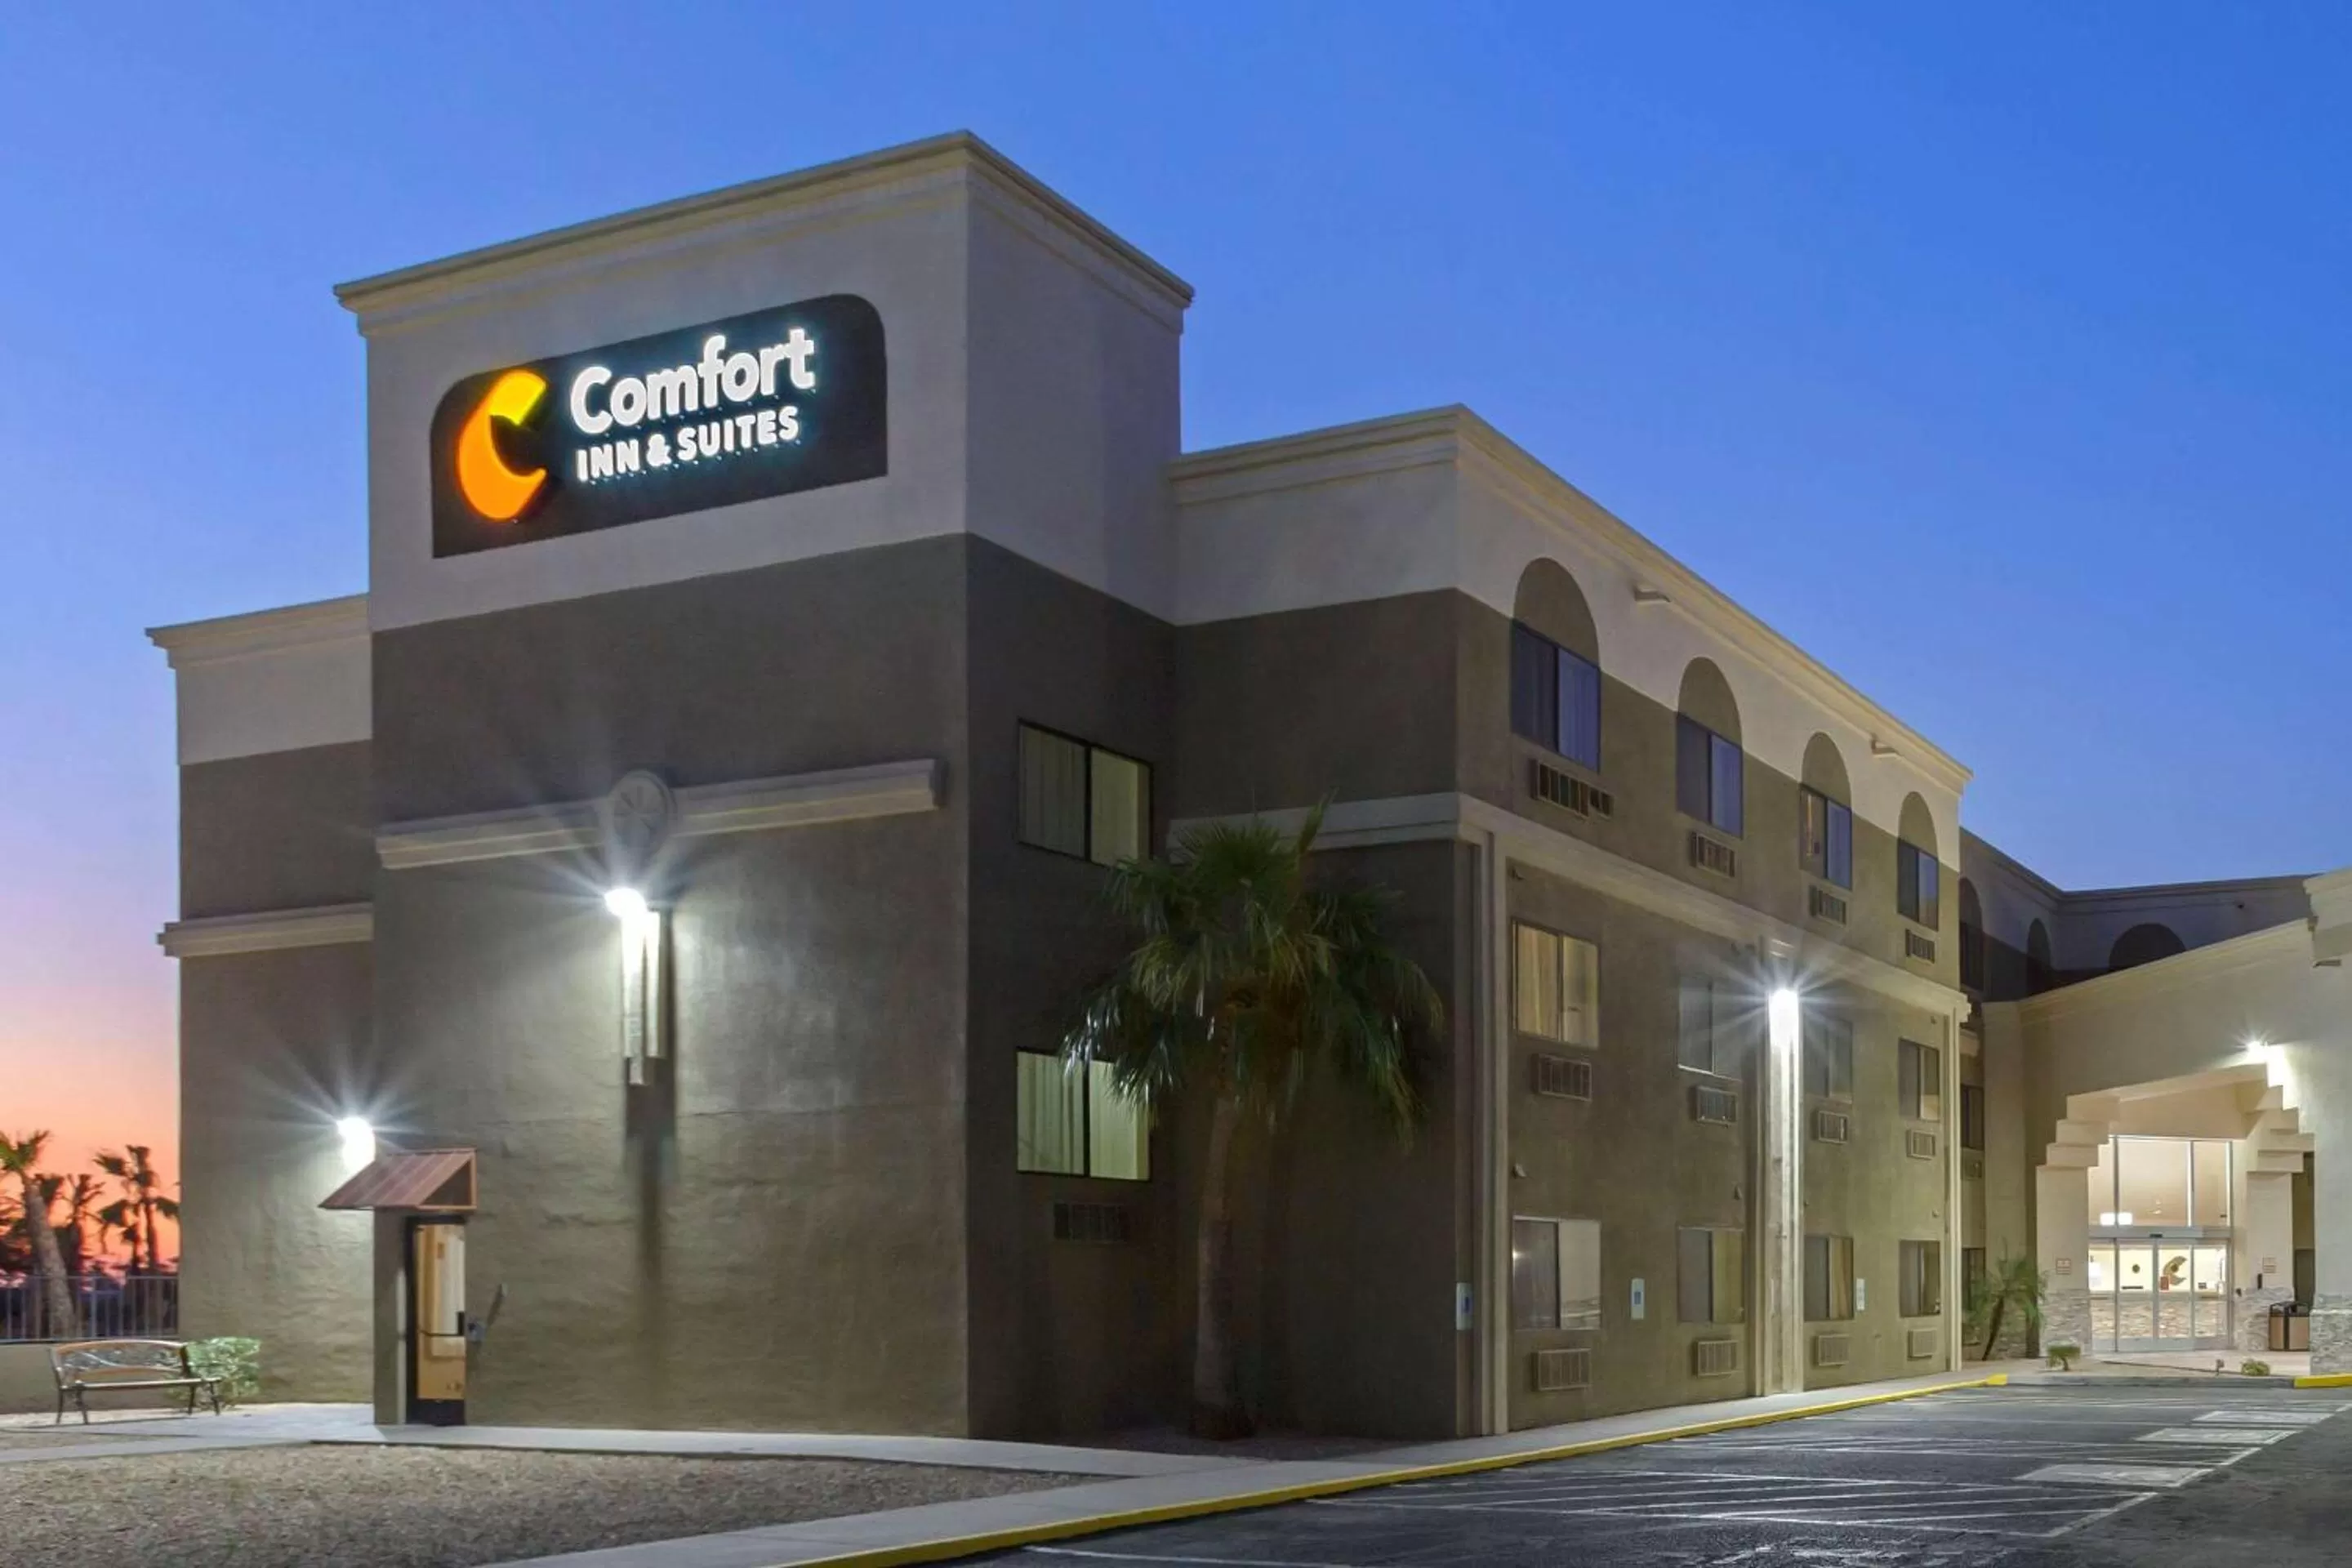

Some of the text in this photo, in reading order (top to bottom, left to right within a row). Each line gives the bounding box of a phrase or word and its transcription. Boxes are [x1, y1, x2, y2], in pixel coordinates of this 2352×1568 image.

[570, 327, 815, 434] Comfort
[576, 405, 800, 482] INN & SUITES
